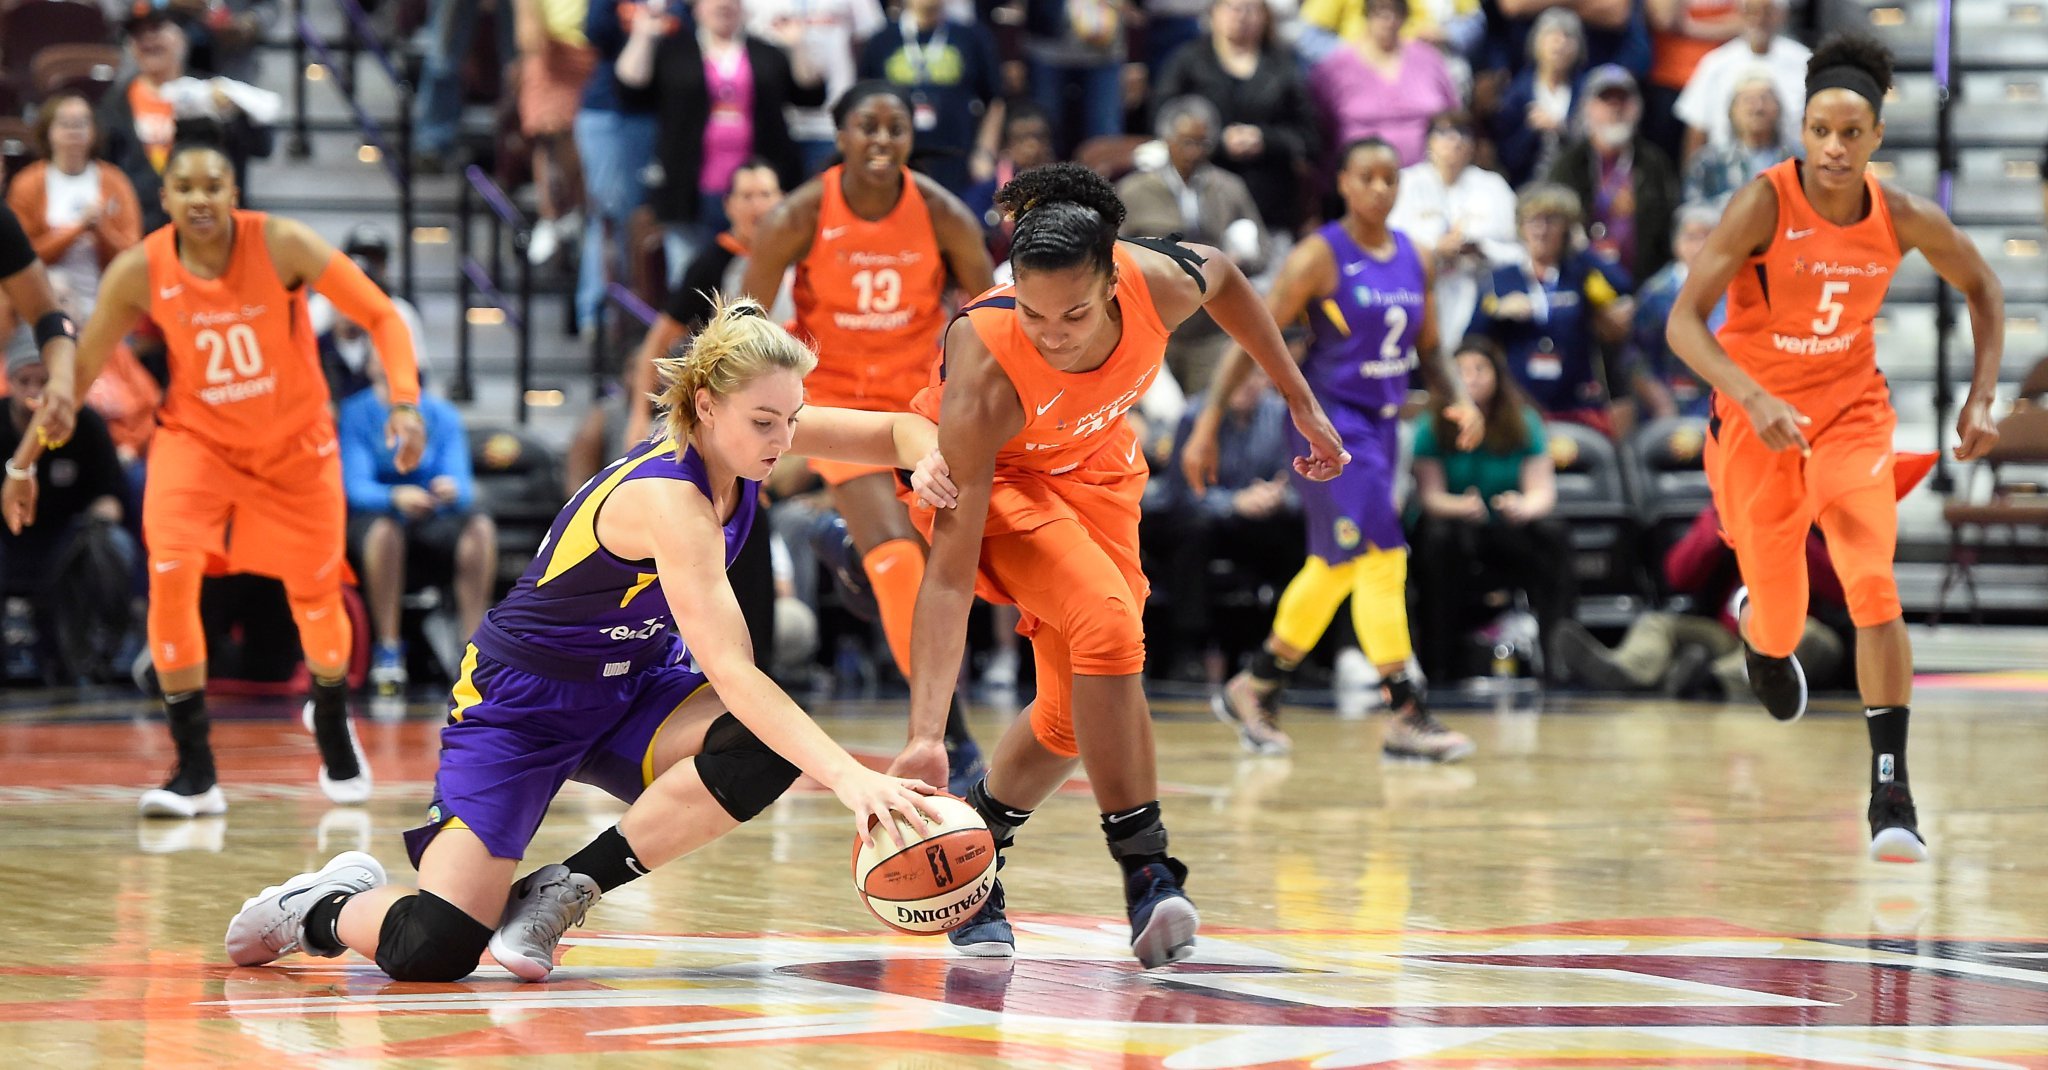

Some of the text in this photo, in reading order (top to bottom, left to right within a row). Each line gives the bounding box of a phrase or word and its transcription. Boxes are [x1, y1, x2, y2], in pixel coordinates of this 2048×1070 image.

[851, 267, 902, 314] 13
[1811, 280, 1850, 336] 5
[195, 323, 264, 385] 20
[1380, 305, 1408, 360] 2
[1772, 333, 1853, 356] verizon
[897, 876, 989, 924] SPALDING
